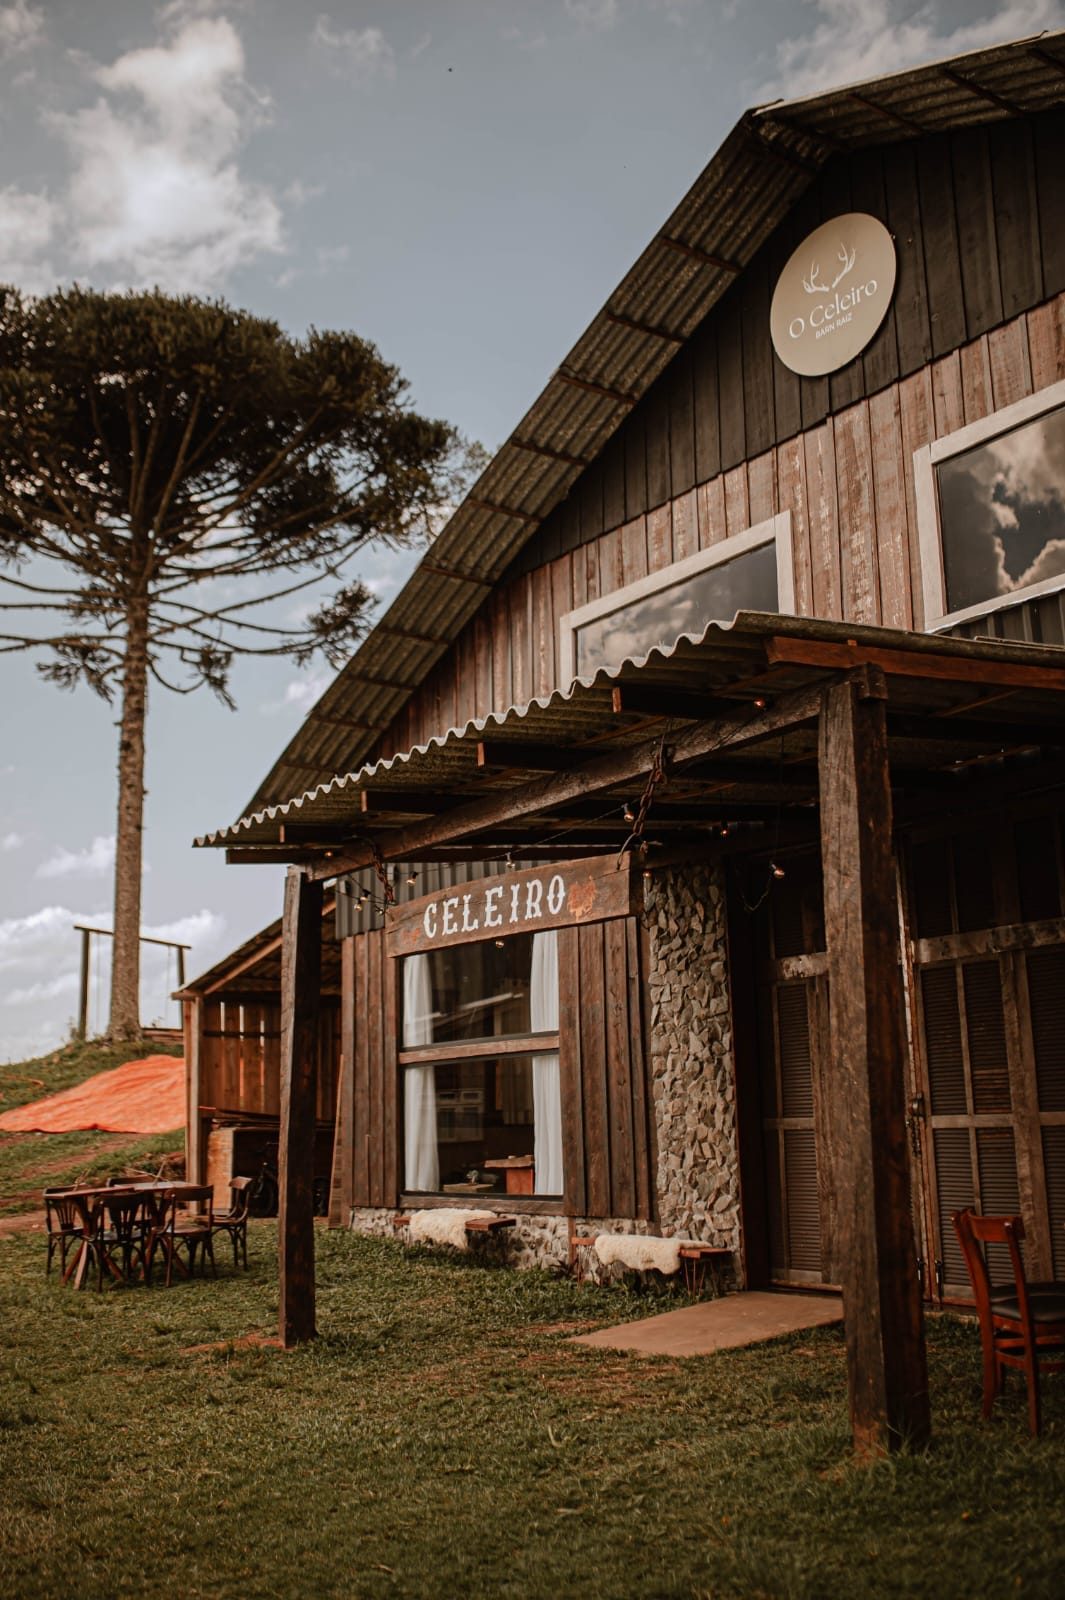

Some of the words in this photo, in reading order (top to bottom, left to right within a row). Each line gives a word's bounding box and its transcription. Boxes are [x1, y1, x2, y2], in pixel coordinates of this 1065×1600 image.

[789, 318, 805, 339] O
[809, 279, 877, 327] Celeiro
[815, 321, 835, 339] BARN
[836, 312, 853, 328] RAIZ
[423, 875, 566, 938] CELEIRO
